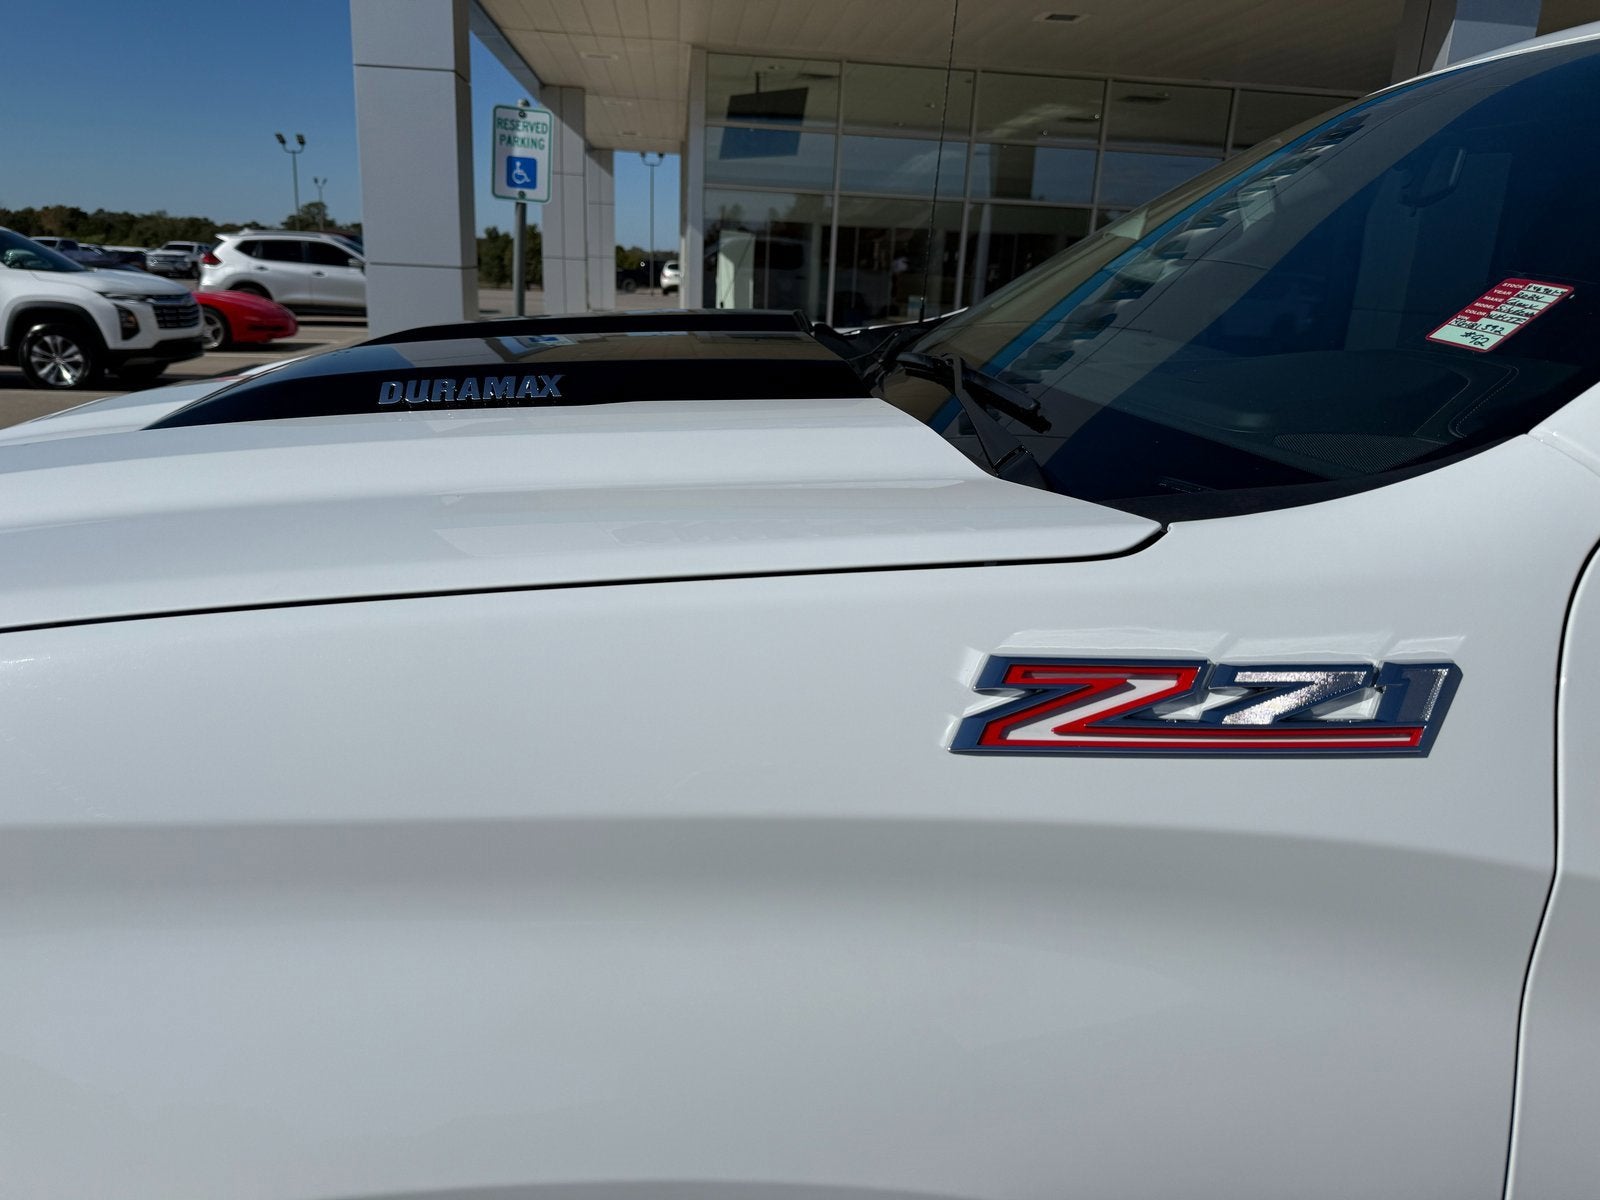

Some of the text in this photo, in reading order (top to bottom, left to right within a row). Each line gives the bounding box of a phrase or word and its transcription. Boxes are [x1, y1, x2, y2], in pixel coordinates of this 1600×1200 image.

[496, 118, 548, 134] RESERVED
[499, 134, 545, 150] PARKING
[378, 374, 566, 405] DURAMAX
[947, 653, 1464, 759] Z71
